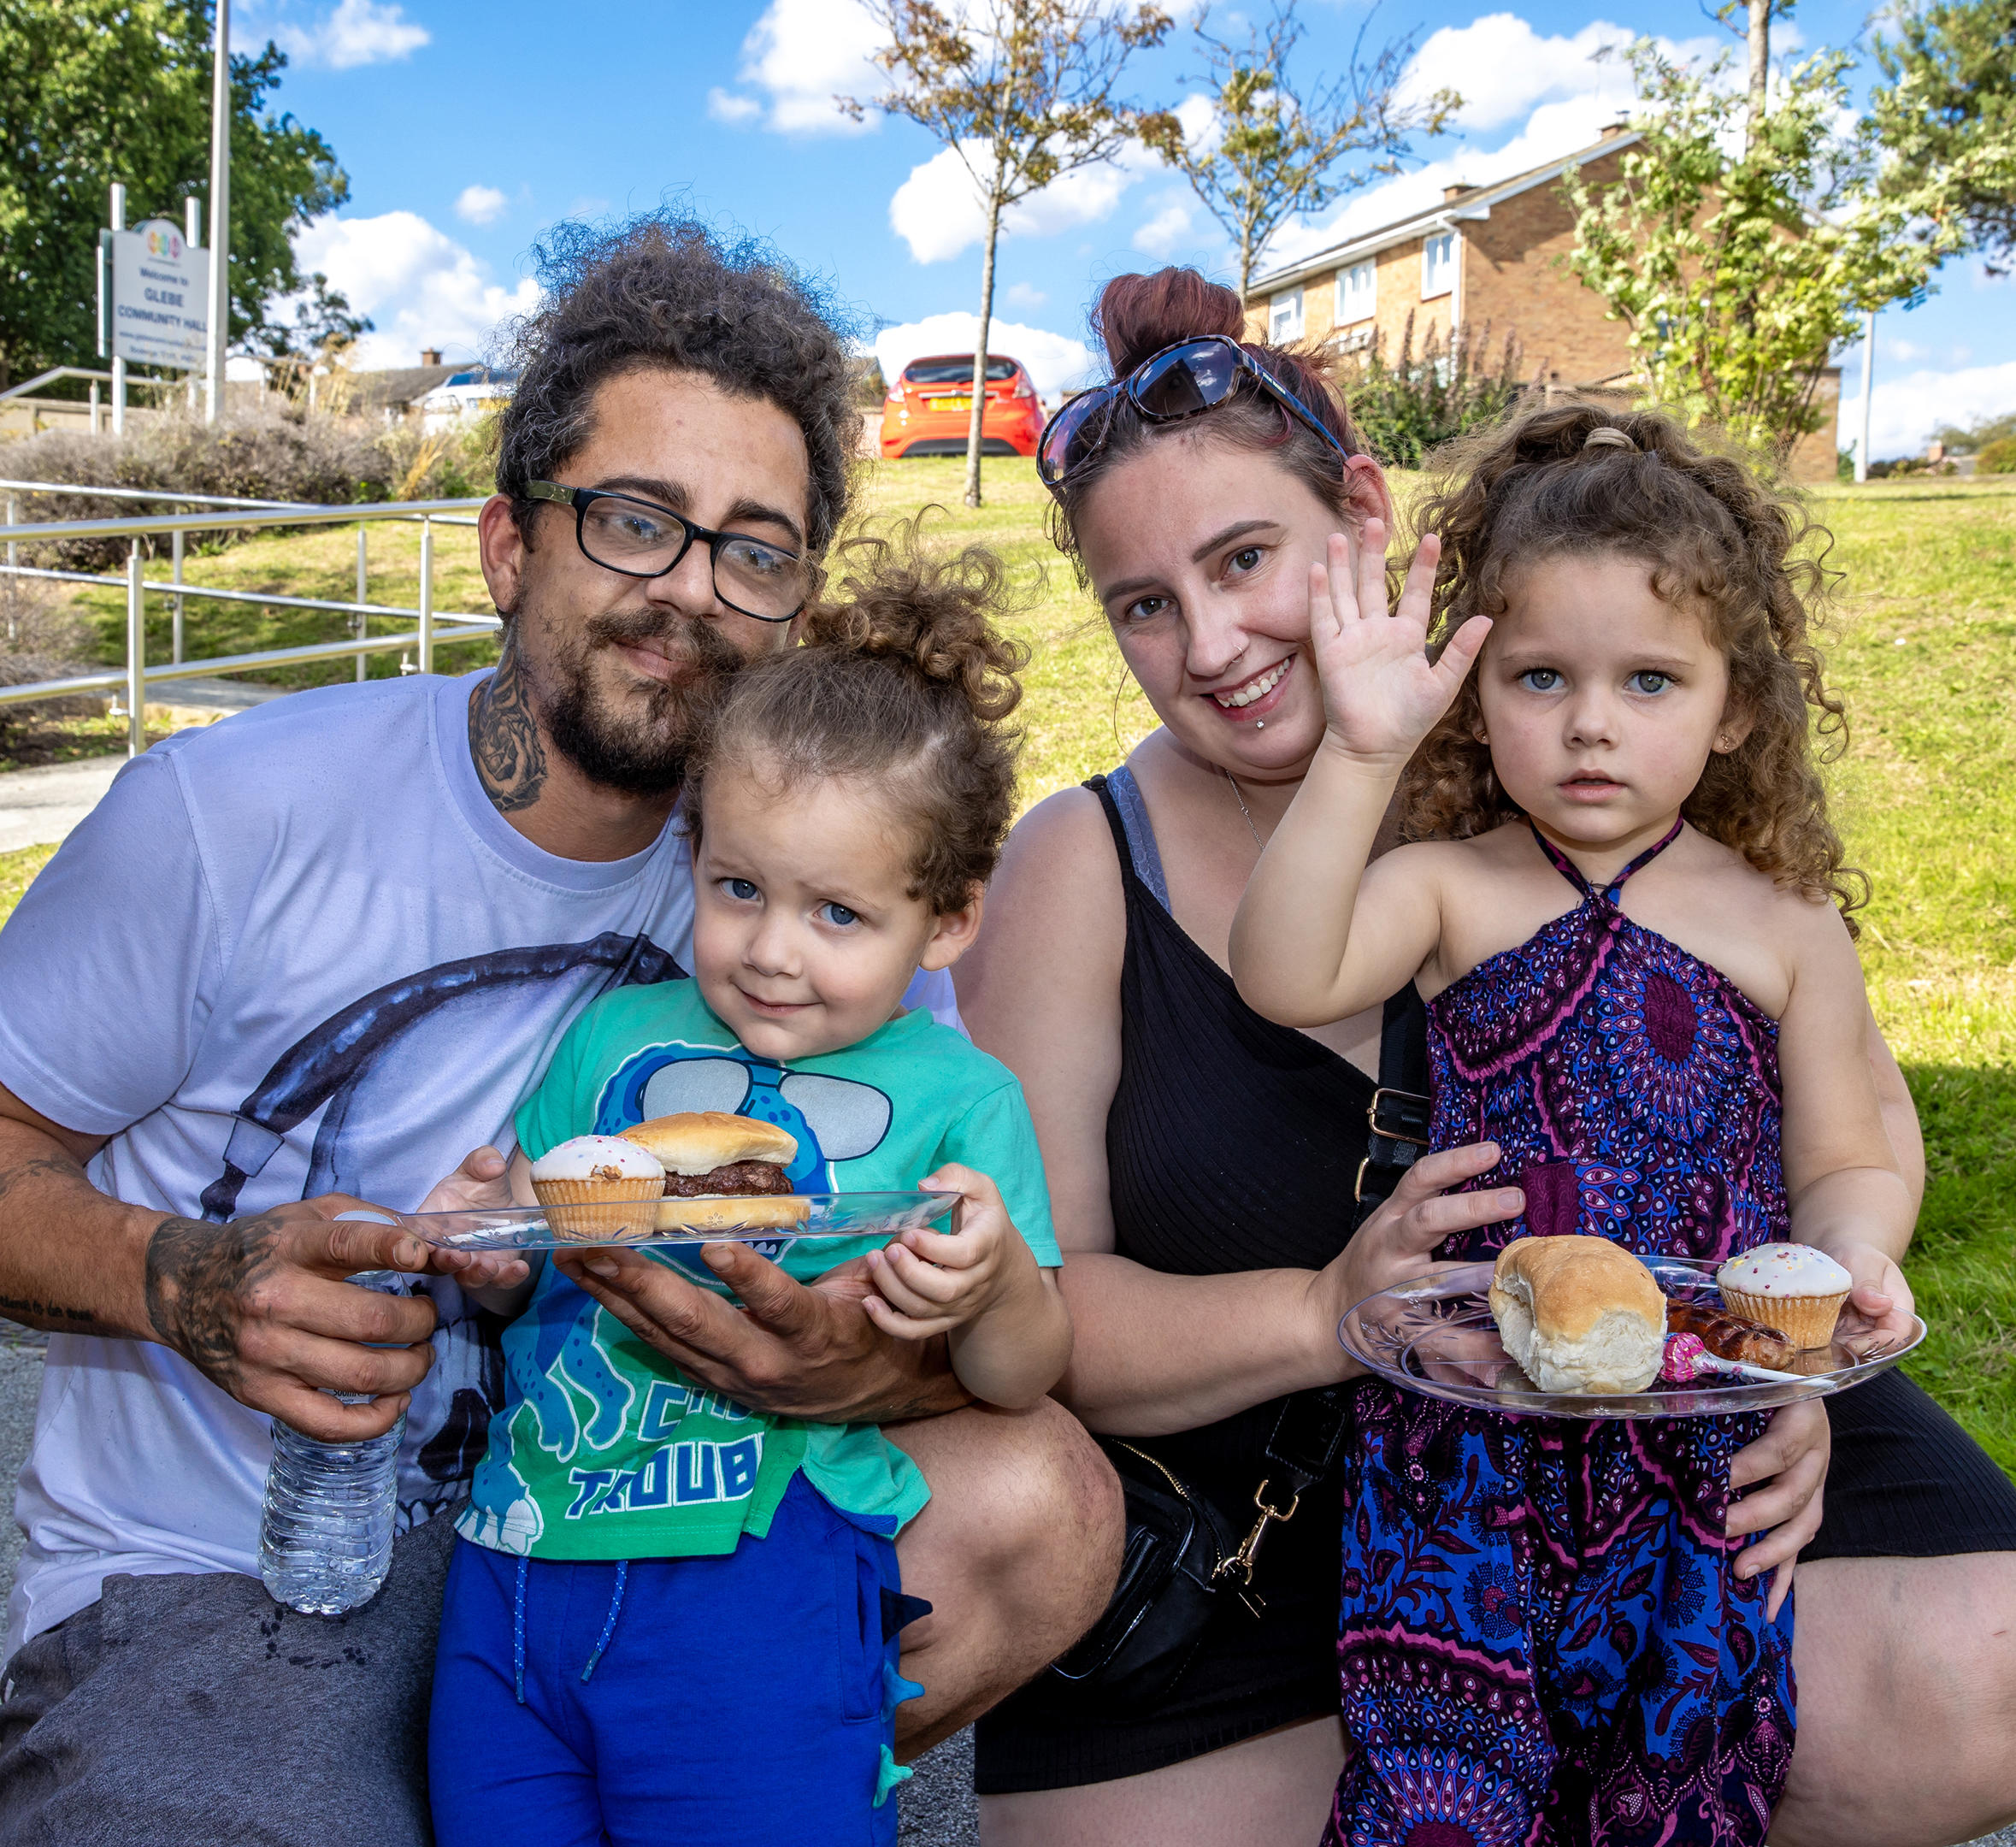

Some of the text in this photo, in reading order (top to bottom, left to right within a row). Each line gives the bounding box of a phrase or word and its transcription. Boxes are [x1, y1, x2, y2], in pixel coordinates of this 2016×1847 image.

[139, 267, 190, 286] Welcome to
[144, 287, 184, 308] GLEBE
[117, 304, 208, 333] COMMUNITY HALL
